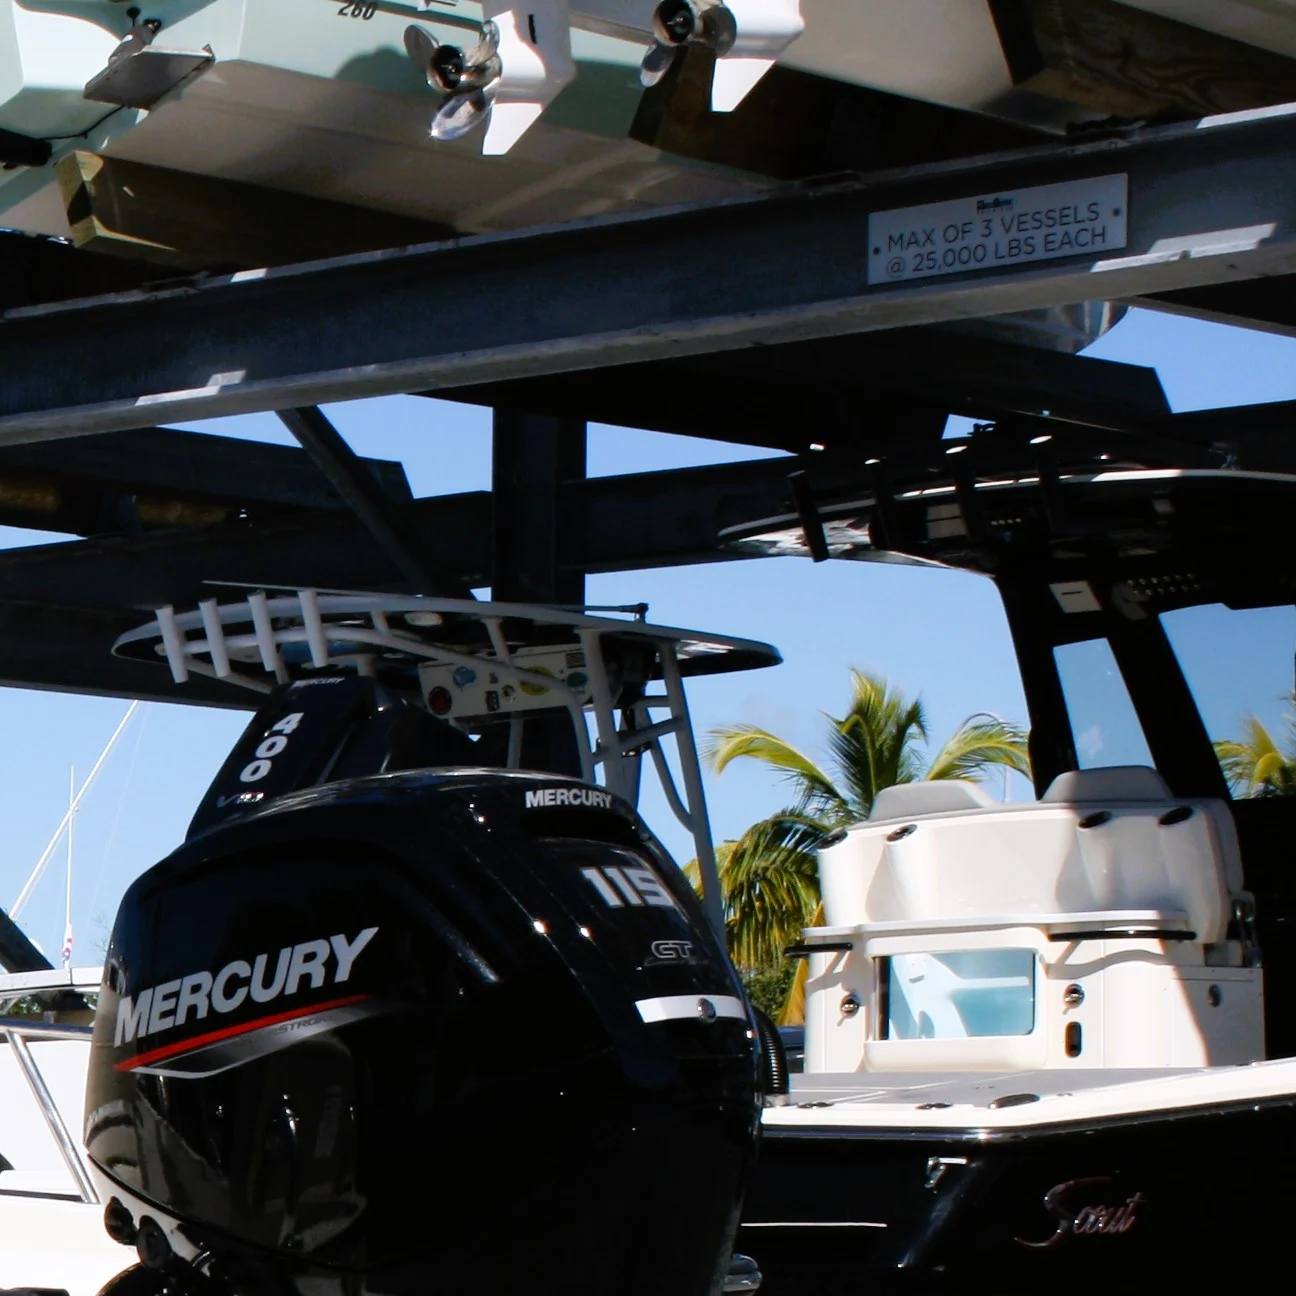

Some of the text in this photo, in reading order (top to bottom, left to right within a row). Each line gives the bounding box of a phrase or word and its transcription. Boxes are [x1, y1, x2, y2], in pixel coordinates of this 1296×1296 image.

[886, 225, 1107, 279] @ 25,000 LBS EACH
[888, 228, 936, 252] MAX
[943, 222, 974, 244] OF
[981, 219, 993, 239] 3
[1001, 202, 1100, 234] VESSELS
[239, 712, 305, 783] 400
[525, 788, 613, 809] MERCURY
[579, 866, 677, 909] 115
[114, 927, 380, 1048] MERCURY
[1014, 1176, 1146, 1247] Scout
